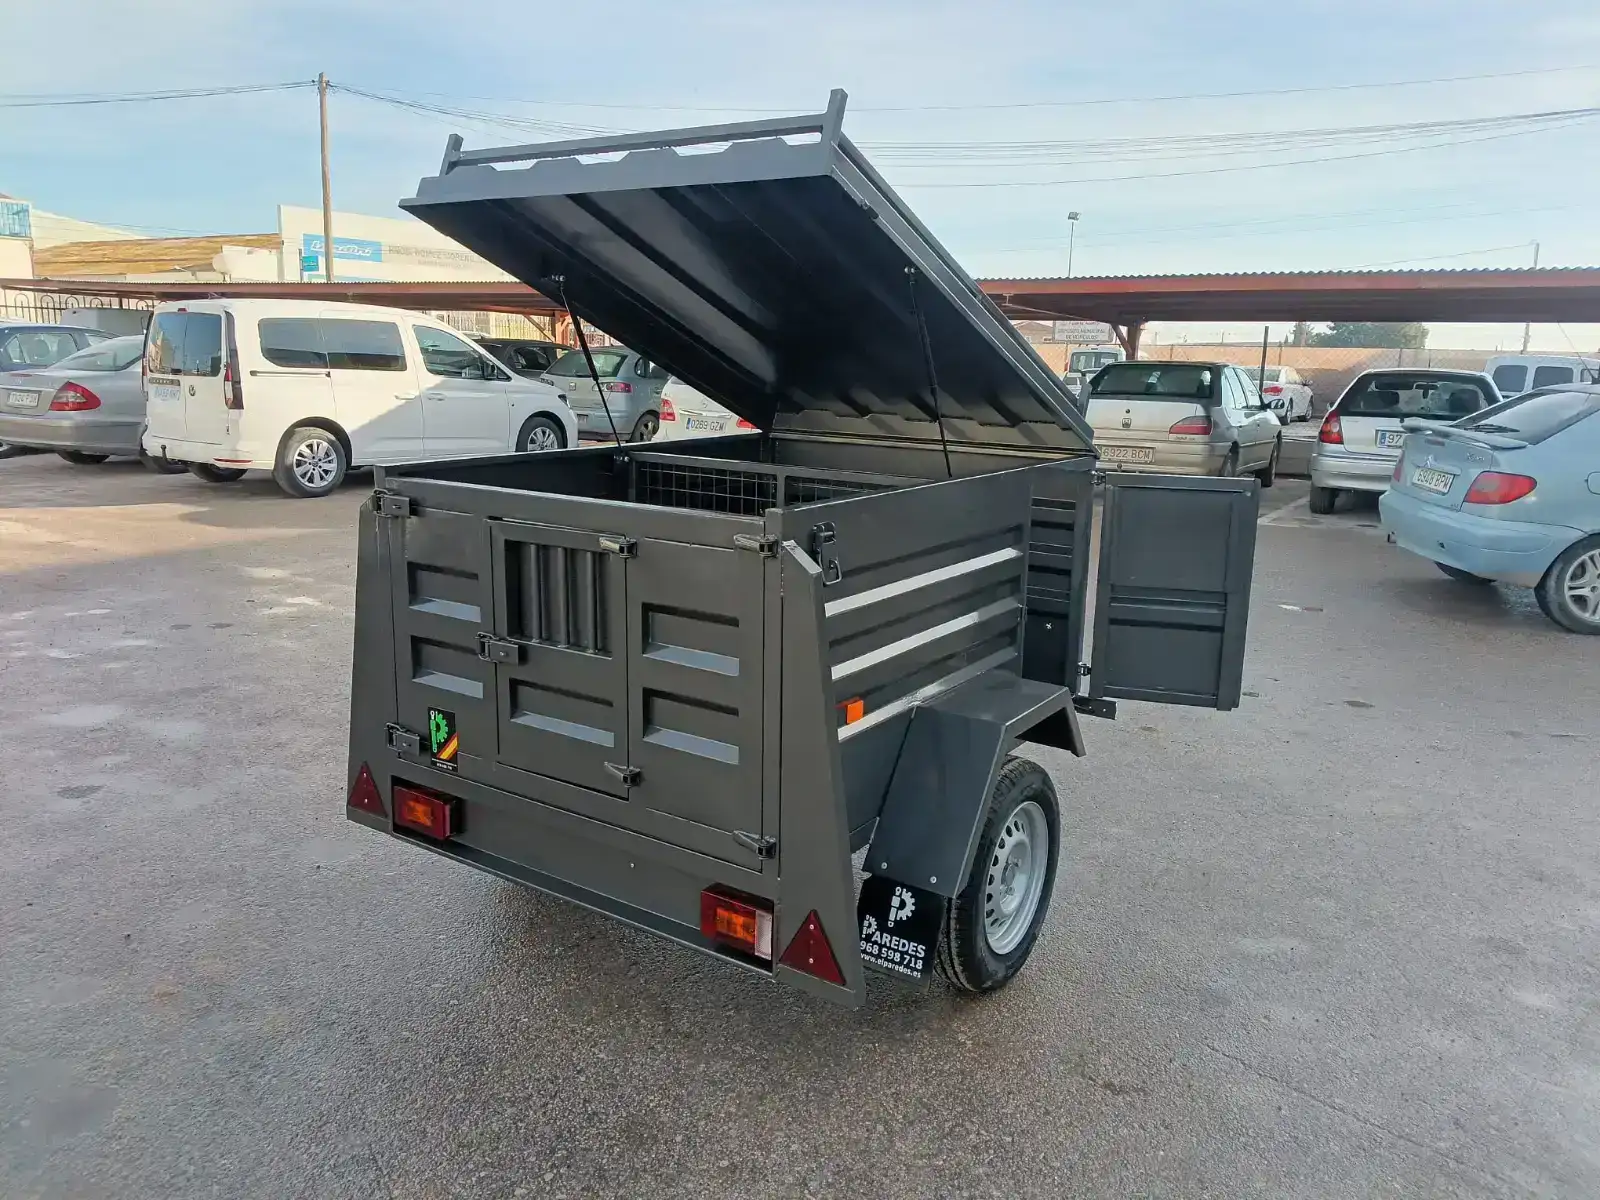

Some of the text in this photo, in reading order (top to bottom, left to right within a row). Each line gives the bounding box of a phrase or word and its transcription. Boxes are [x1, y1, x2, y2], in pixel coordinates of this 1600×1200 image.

[690, 419, 707, 430] 0269
[1103, 448, 1129, 458] 6922
[860, 940, 923, 970] 968 598 718
